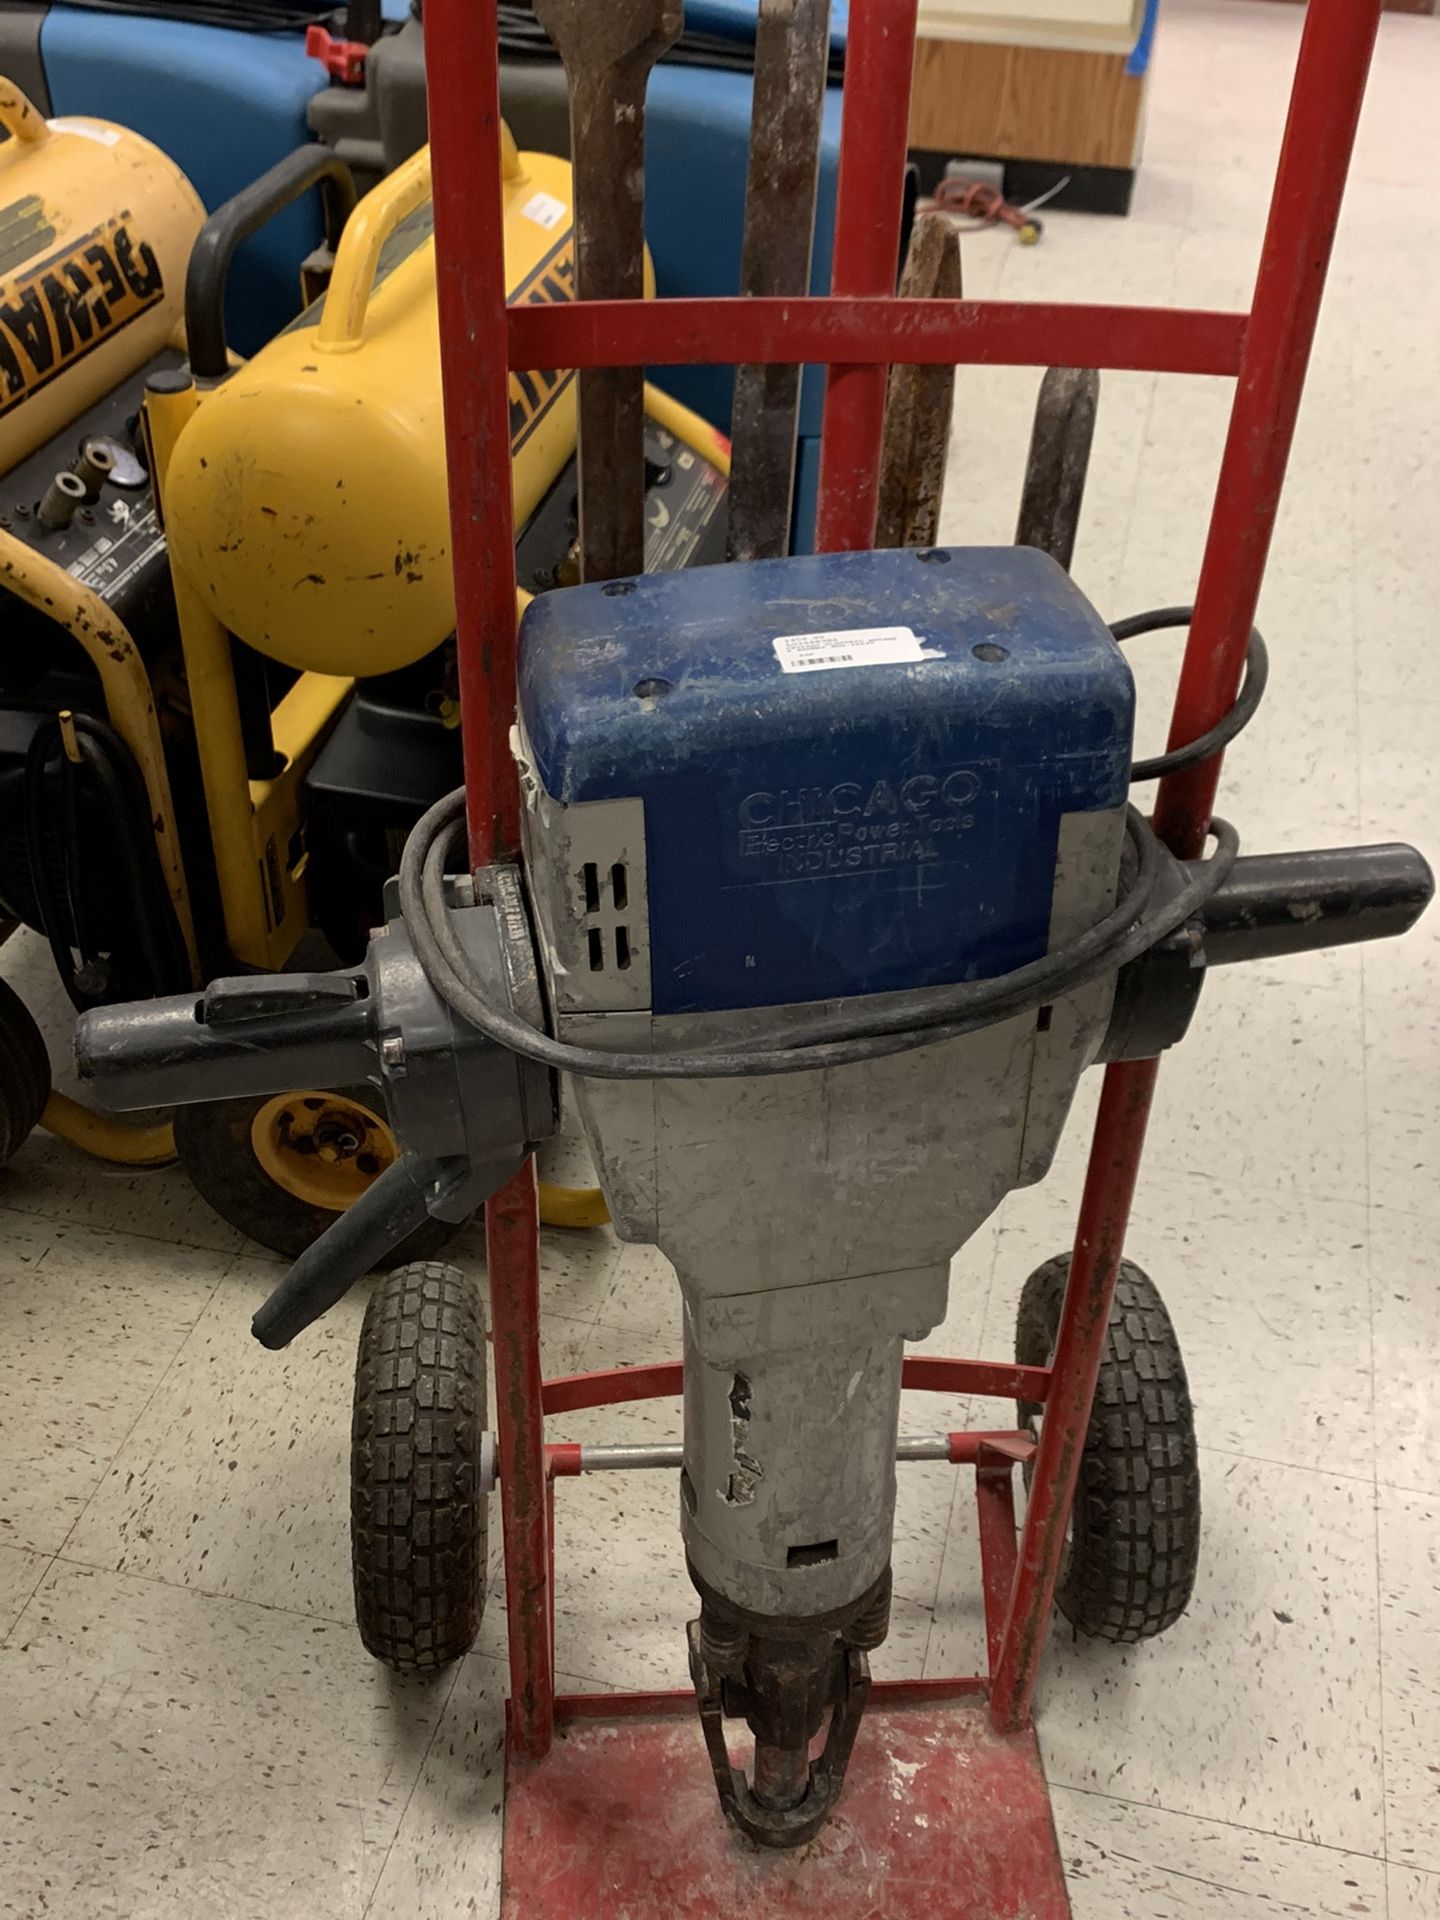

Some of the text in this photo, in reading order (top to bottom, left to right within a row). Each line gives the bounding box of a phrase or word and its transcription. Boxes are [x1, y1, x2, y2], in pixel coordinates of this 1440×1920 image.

[740, 770, 980, 827] CHICAGO
[741, 813, 976, 857] Electric Power Tools
[780, 839, 940, 874] INDUSTRIAL
